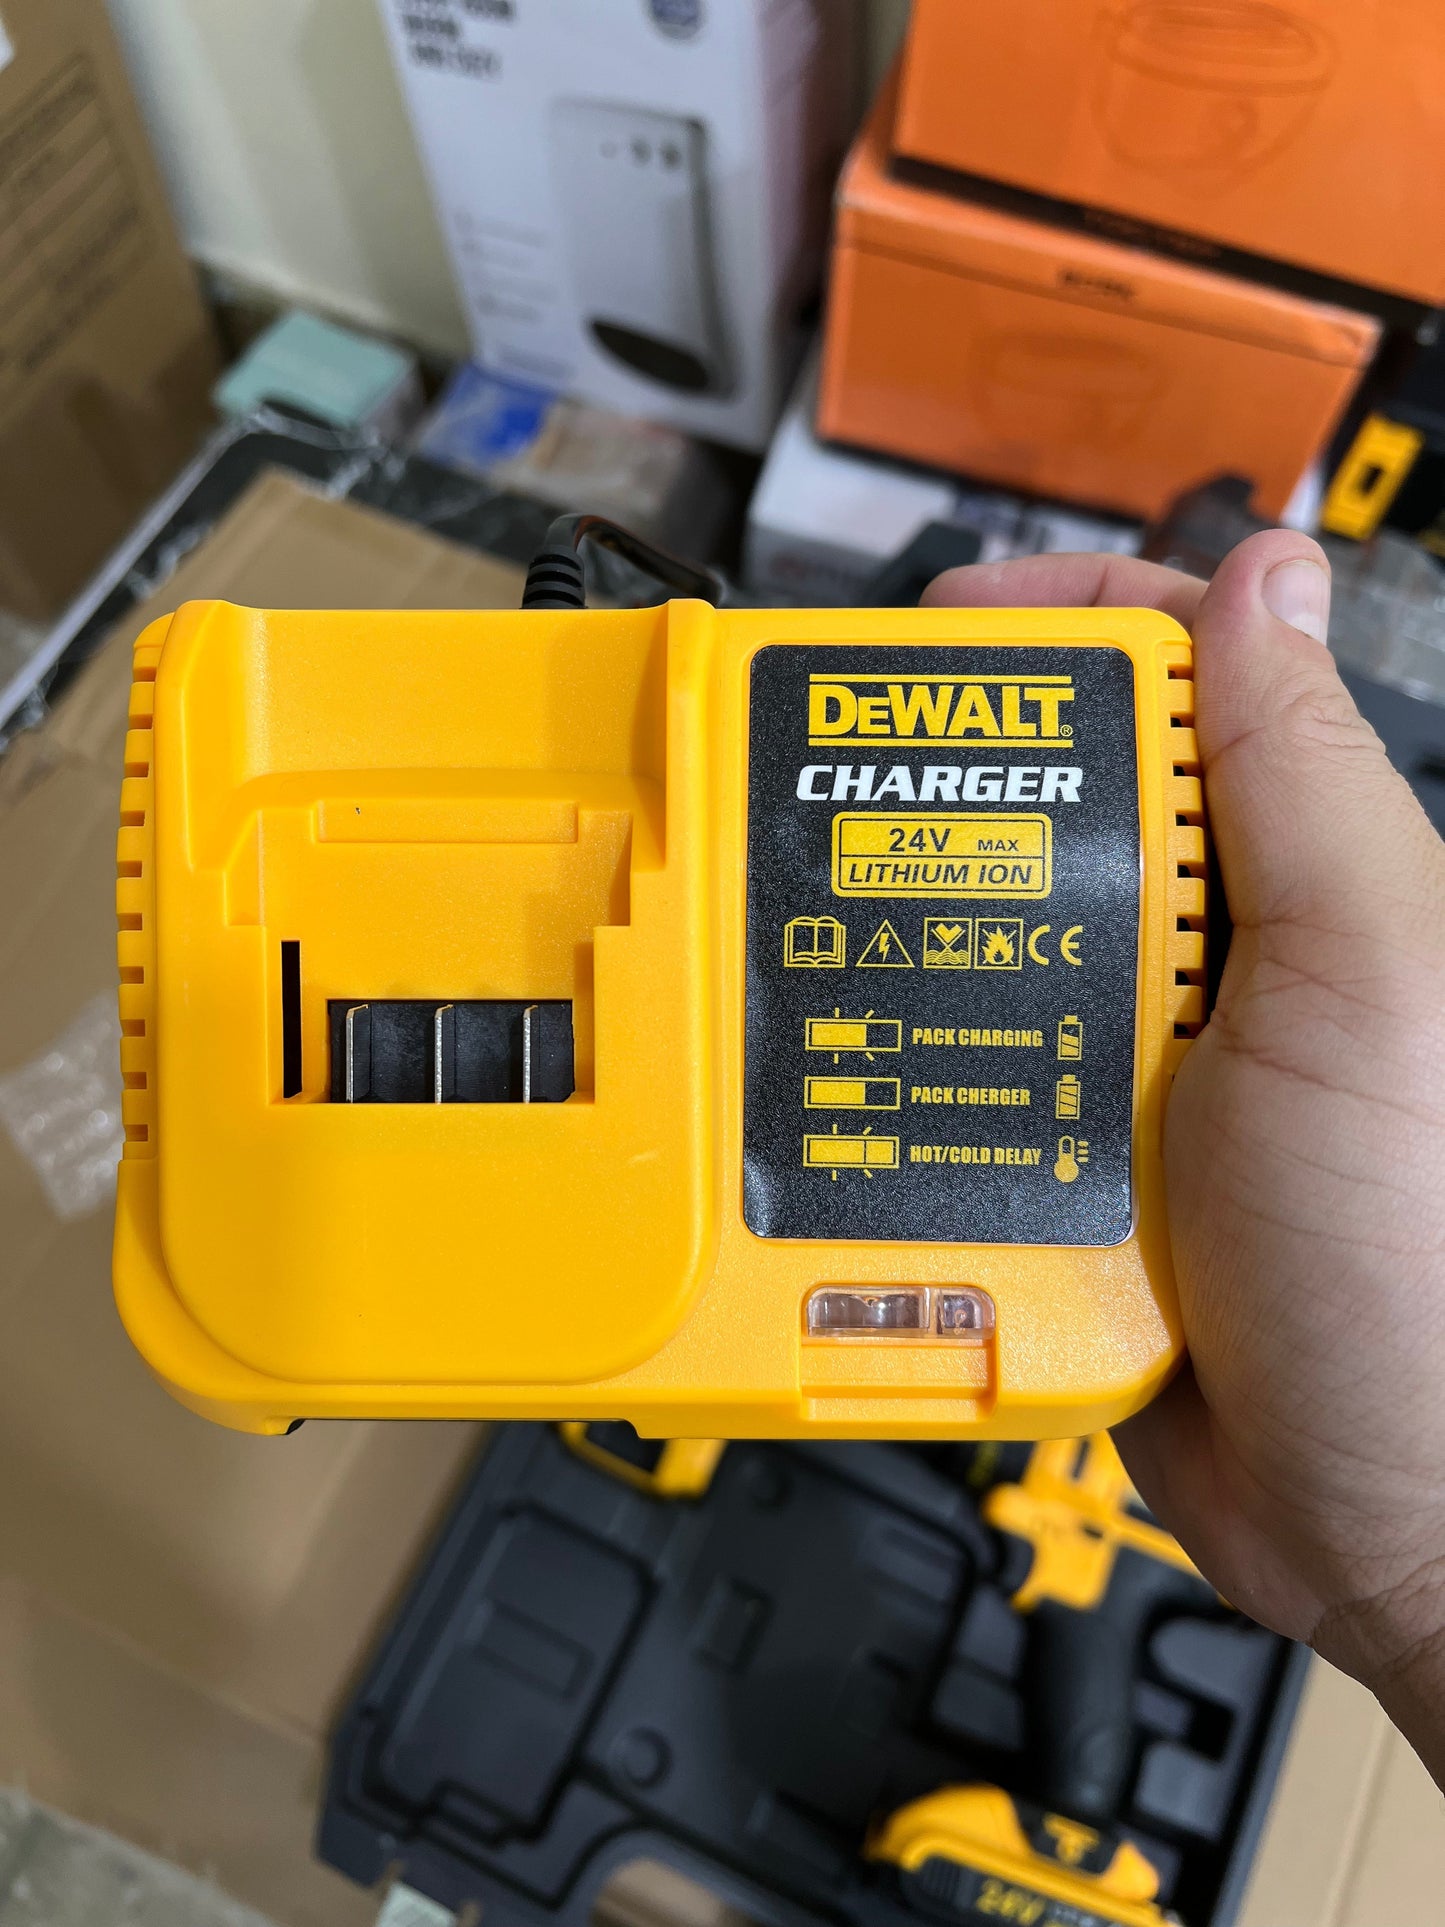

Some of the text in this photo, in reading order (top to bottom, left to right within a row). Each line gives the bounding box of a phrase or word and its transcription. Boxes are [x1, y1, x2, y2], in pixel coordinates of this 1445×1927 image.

[796, 764, 1084, 802] CHARGER
[889, 828, 1019, 852] 24V MAX
[848, 863, 1032, 885] LITHIUM ION
[912, 1028, 1043, 1047] PACK CHARGING
[911, 1086, 1031, 1106] PACK CHERGER
[909, 1145, 1043, 1166] HOT/COLD DELAY
